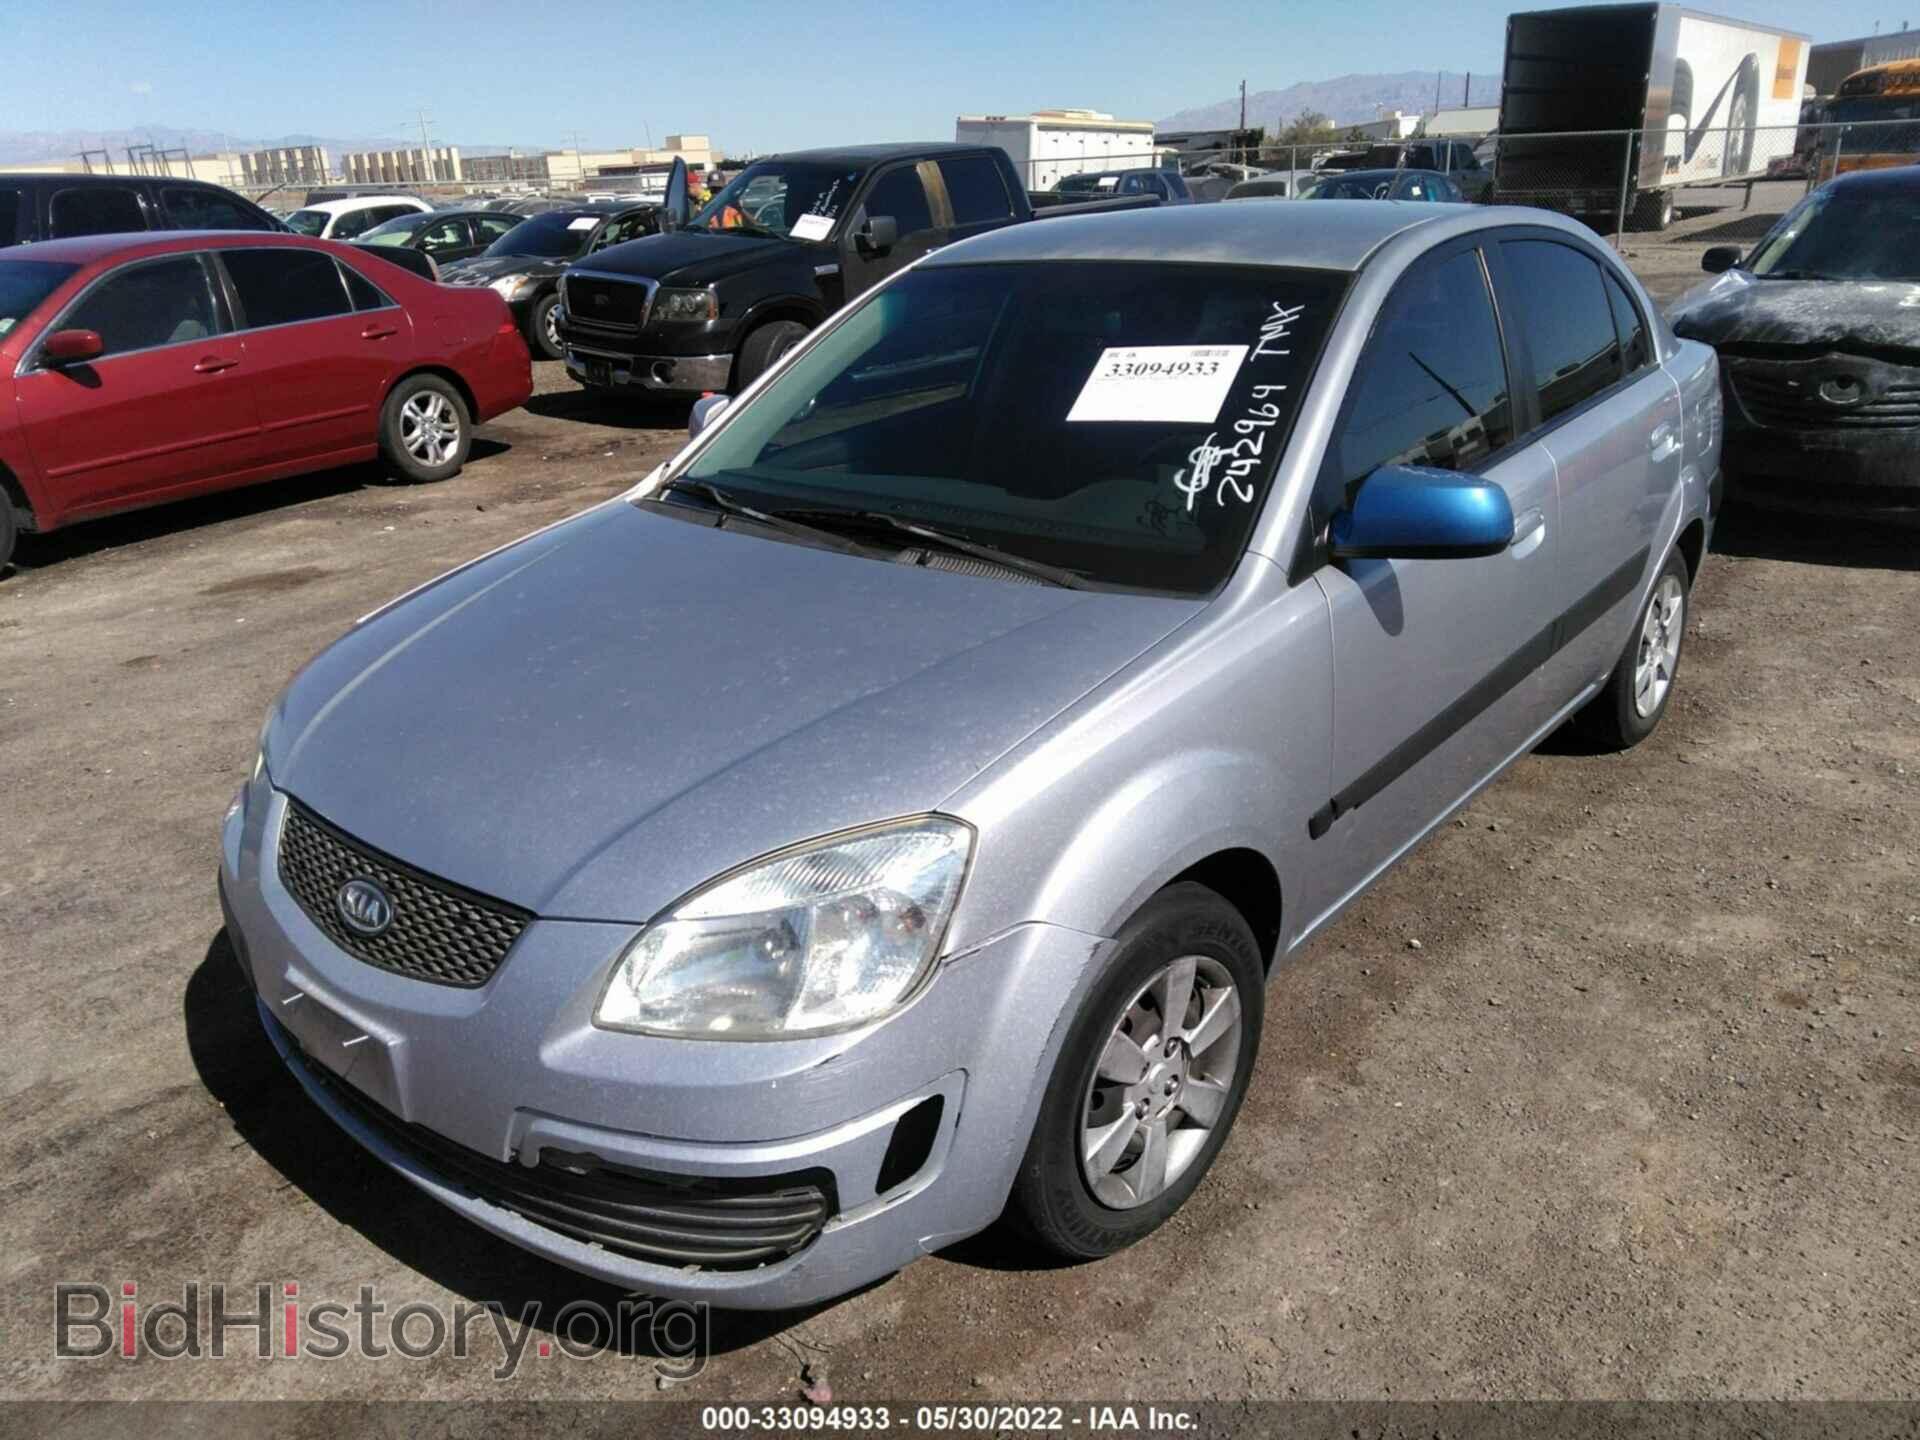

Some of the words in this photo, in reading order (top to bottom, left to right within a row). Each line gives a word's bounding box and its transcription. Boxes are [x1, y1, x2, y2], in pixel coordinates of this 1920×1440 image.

[1105, 361, 1219, 377] 33094933
[1217, 384, 1287, 507] 242964
[342, 886, 381, 927] KIA
